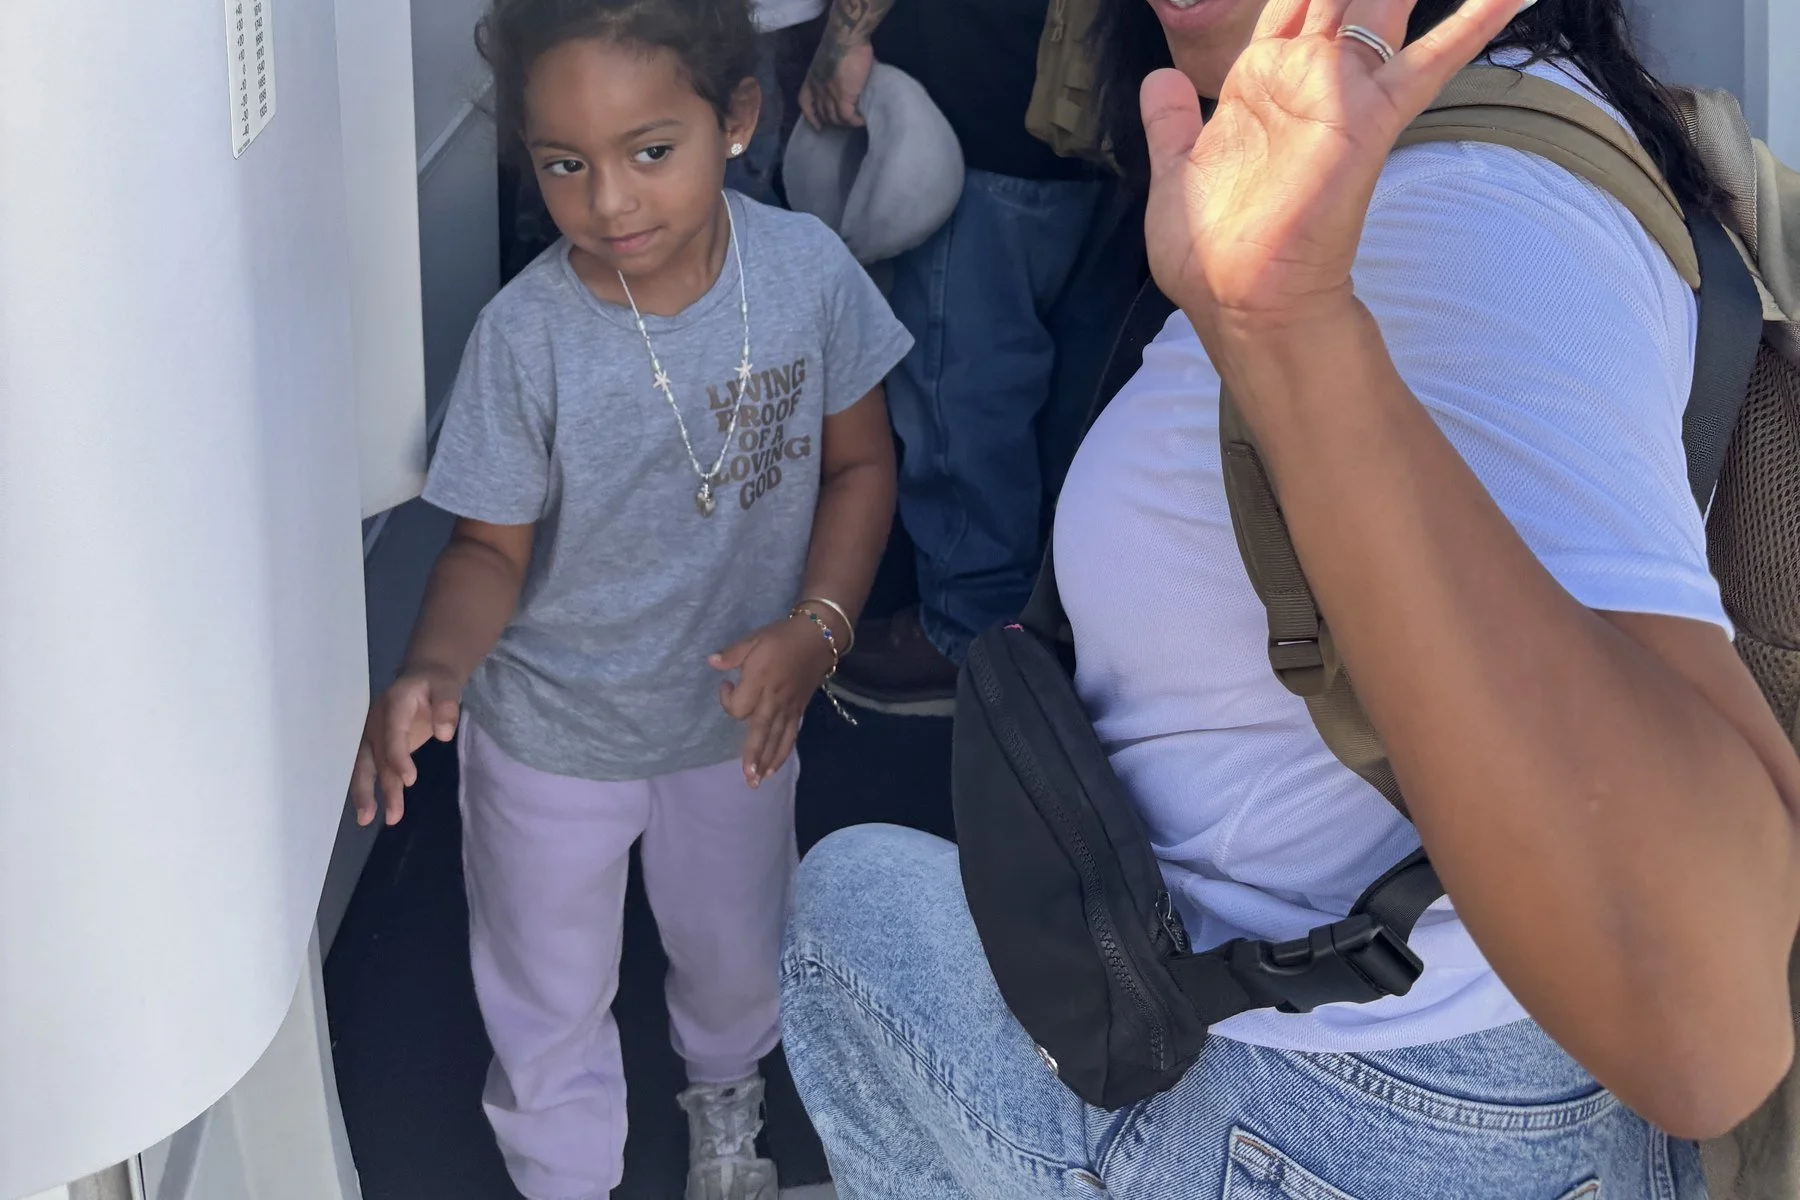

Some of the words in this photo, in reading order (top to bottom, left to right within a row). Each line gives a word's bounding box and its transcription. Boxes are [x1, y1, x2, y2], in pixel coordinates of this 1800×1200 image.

[706, 357, 806, 410] LIVING
[715, 387, 803, 433] PROOF
[711, 435, 811, 487] LOVING
[739, 427, 770, 453] OF
[771, 423, 784, 448] A
[740, 465, 782, 511] GOD
